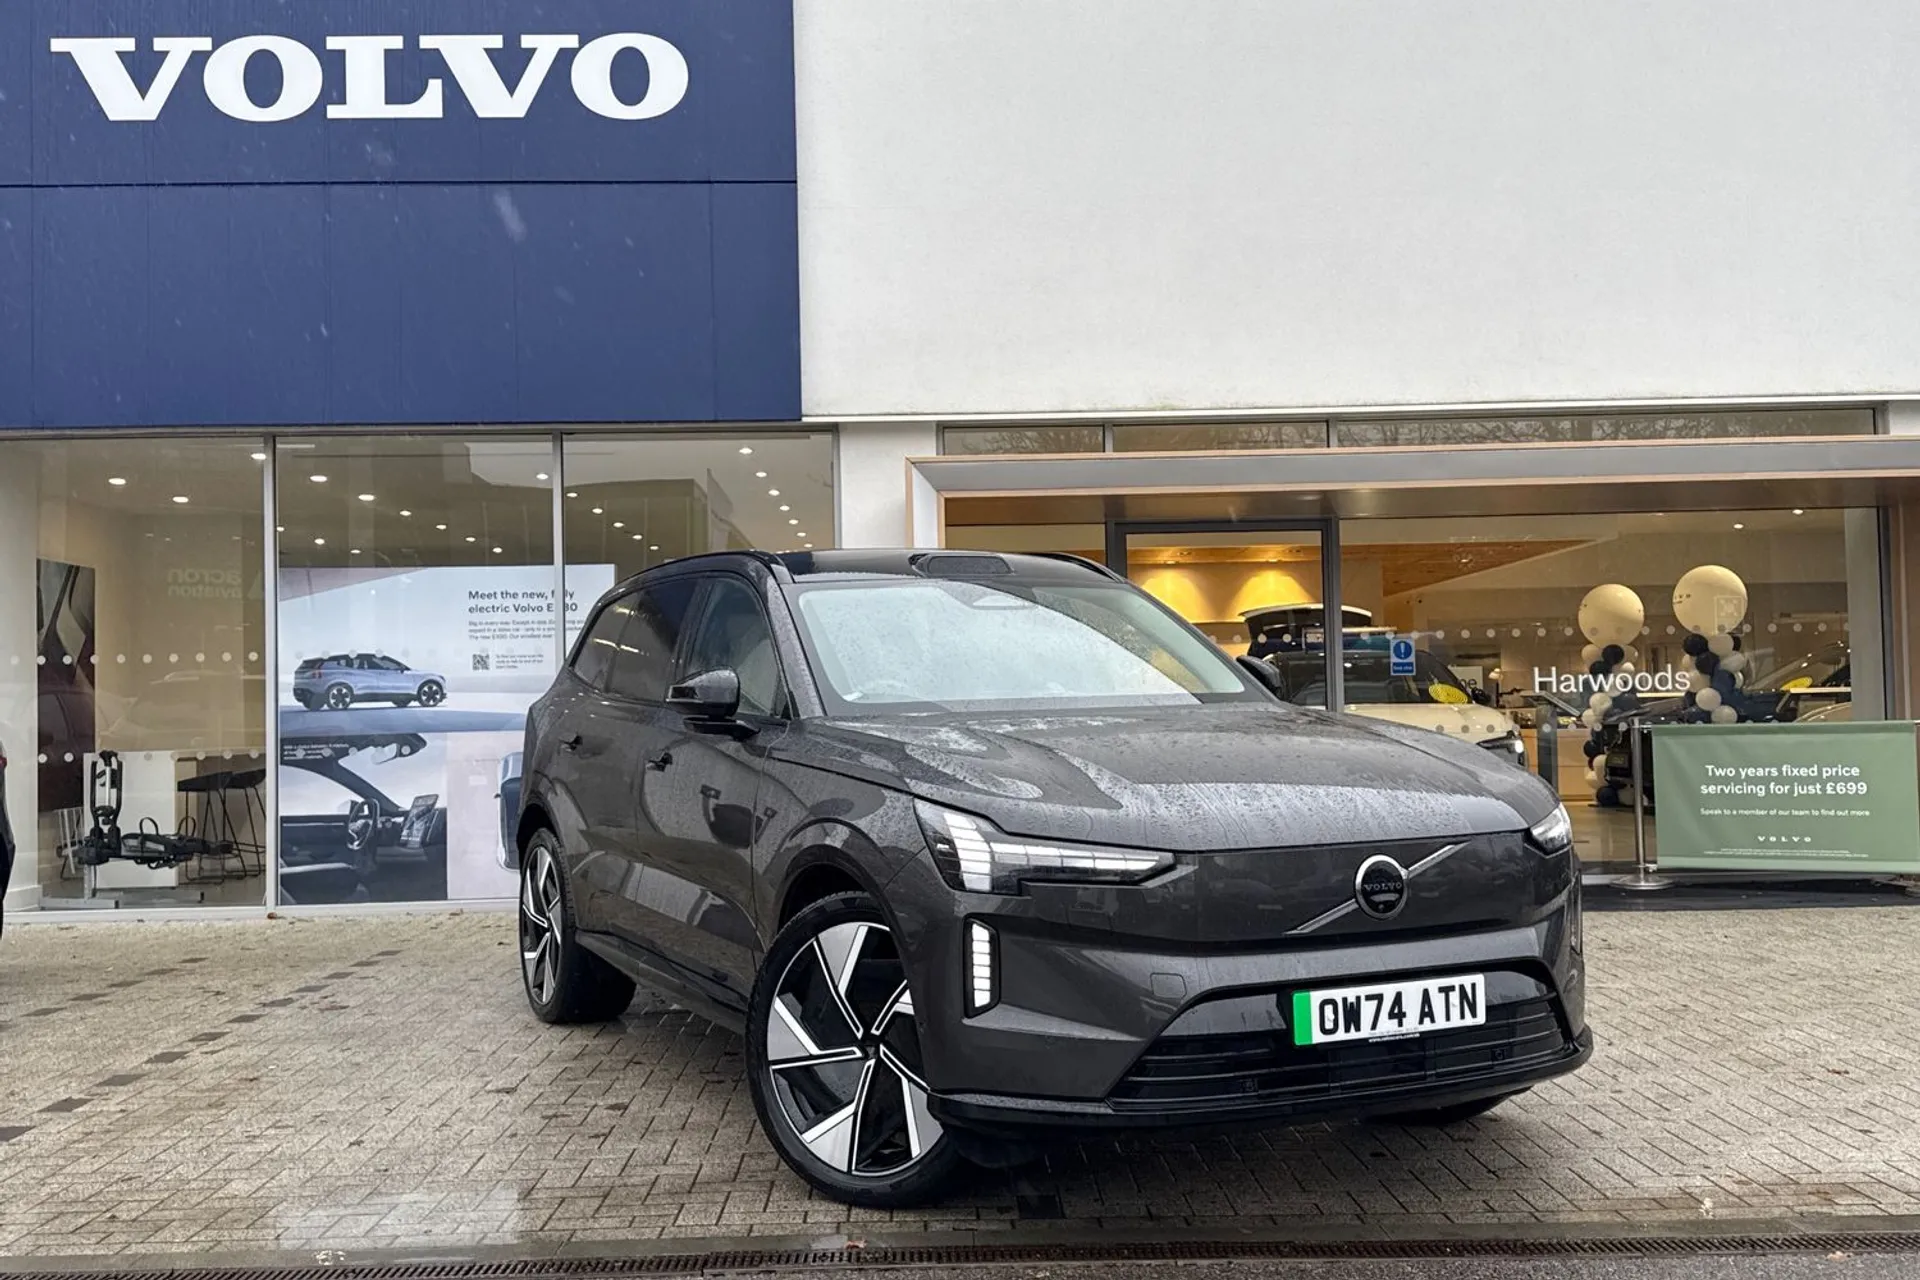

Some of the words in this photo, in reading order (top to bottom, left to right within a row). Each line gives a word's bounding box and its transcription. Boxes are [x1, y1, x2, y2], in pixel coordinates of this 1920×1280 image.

[50, 32, 689, 122] VOLVO
[468, 590, 497, 600] Meet
[500, 590, 519, 600] the
[521, 591, 548, 601] new,
[551, 590, 575, 600] fly
[468, 604, 510, 613] electric
[513, 604, 543, 613] Volvo
[546, 602, 578, 612] E30
[1533, 664, 1691, 694] Harwoods
[1705, 765, 1736, 777] Two
[1739, 767, 1778, 779] years
[1782, 764, 1818, 777] fixed
[1822, 764, 1860, 779] price
[1700, 782, 1766, 797] servicing
[1769, 782, 1790, 795] for
[1793, 782, 1822, 797] just
[1825, 782, 1868, 796] £699
[1700, 808, 1722, 816] Speak
[1791, 808, 1810, 816] team
[1757, 835, 1812, 843] VOLVO
[1363, 882, 1402, 891] VOLVO
[1319, 991, 1406, 1036] OW74
[1418, 982, 1477, 1025] ATN
